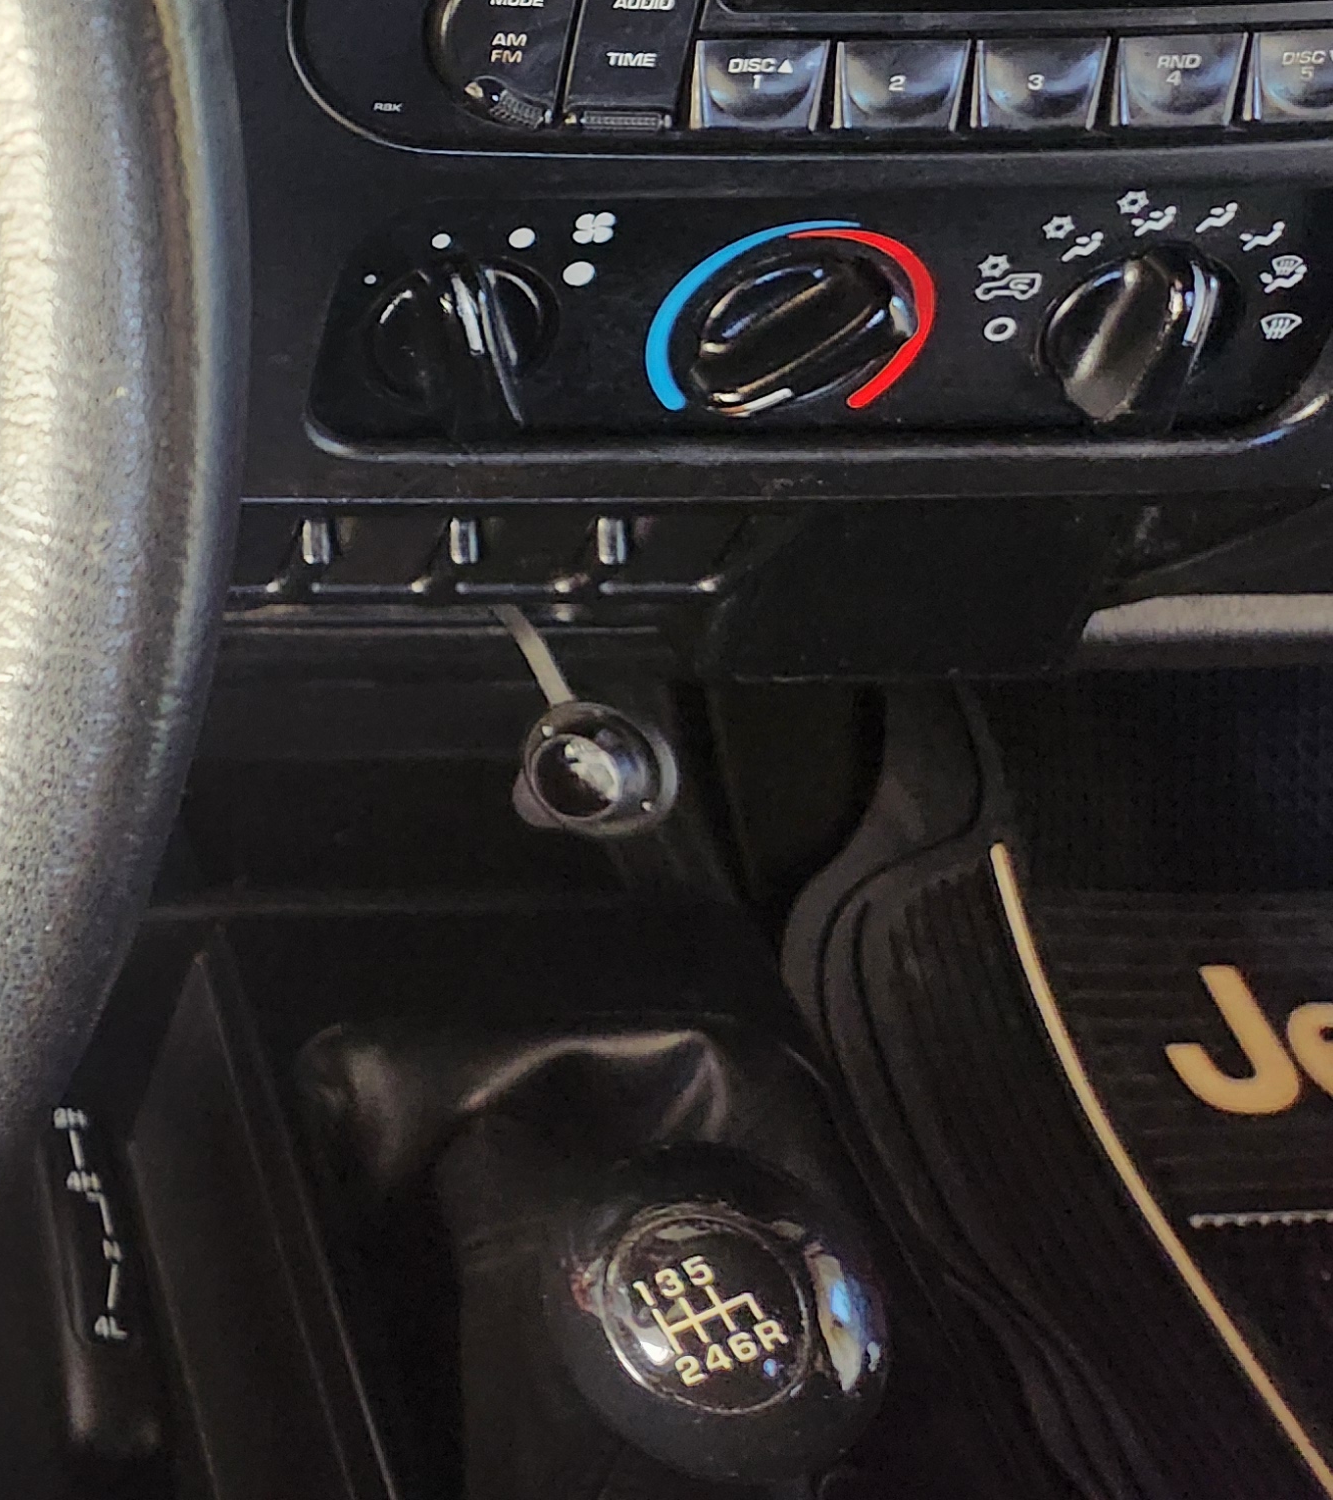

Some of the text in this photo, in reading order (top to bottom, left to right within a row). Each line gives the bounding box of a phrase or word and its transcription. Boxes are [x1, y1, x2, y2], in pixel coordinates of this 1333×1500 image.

[491, 32, 528, 48] AM
[490, 50, 523, 65] FM
[606, 52, 657, 69] TIME
[728, 57, 776, 75] DISC
[1156, 52, 1202, 70] RND
[1282, 50, 1327, 65] DISC
[751, 75, 762, 89] 1
[1165, 69, 1182, 86] 4
[1300, 66, 1315, 81] 5
[889, 74, 906, 92] 2
[1028, 74, 1045, 91] 3
